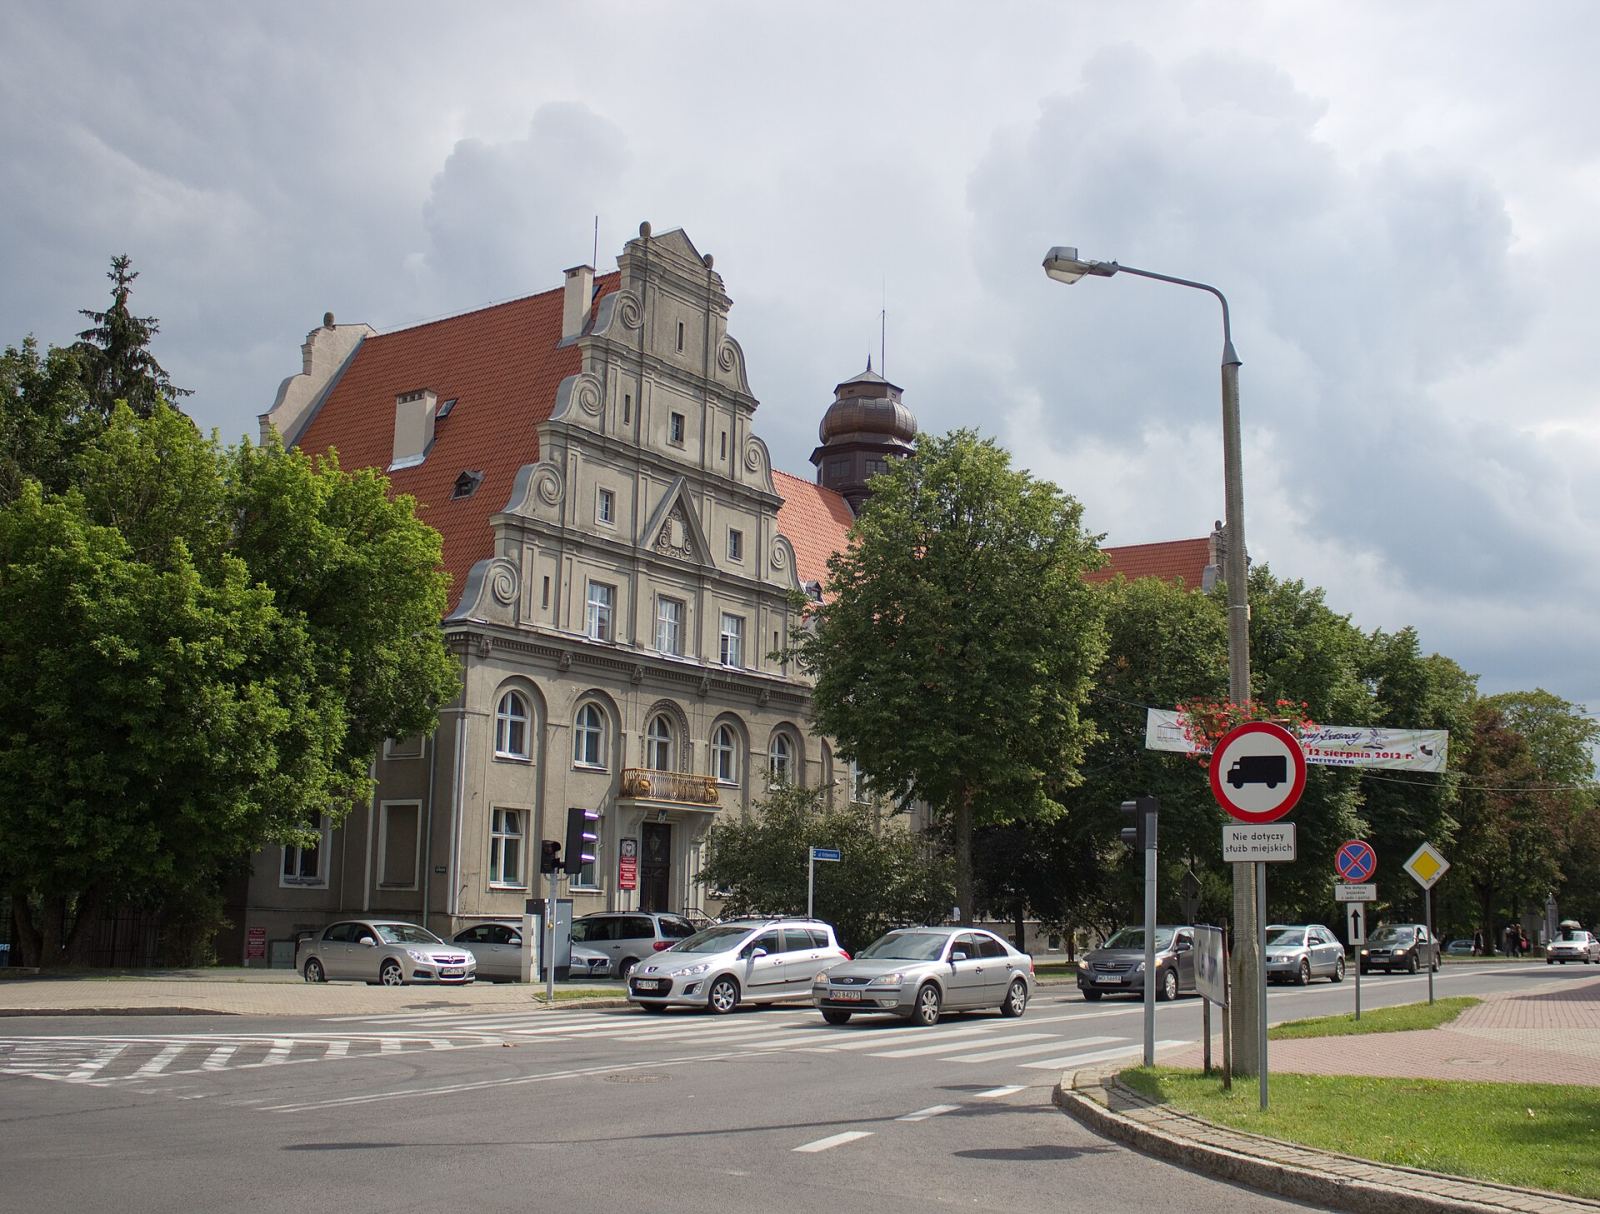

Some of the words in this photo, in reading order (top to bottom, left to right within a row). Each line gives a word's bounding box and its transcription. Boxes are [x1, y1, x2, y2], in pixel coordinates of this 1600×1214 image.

[1308, 748, 1320, 756] 12
[1323, 749, 1371, 759] sierpnia
[1375, 752, 1401, 760] 2012
[1232, 832, 1248, 841] Nie
[1250, 832, 1285, 842] dotyczy
[1225, 844, 1248, 853] służb
[1251, 843, 1293, 854] miejskich
